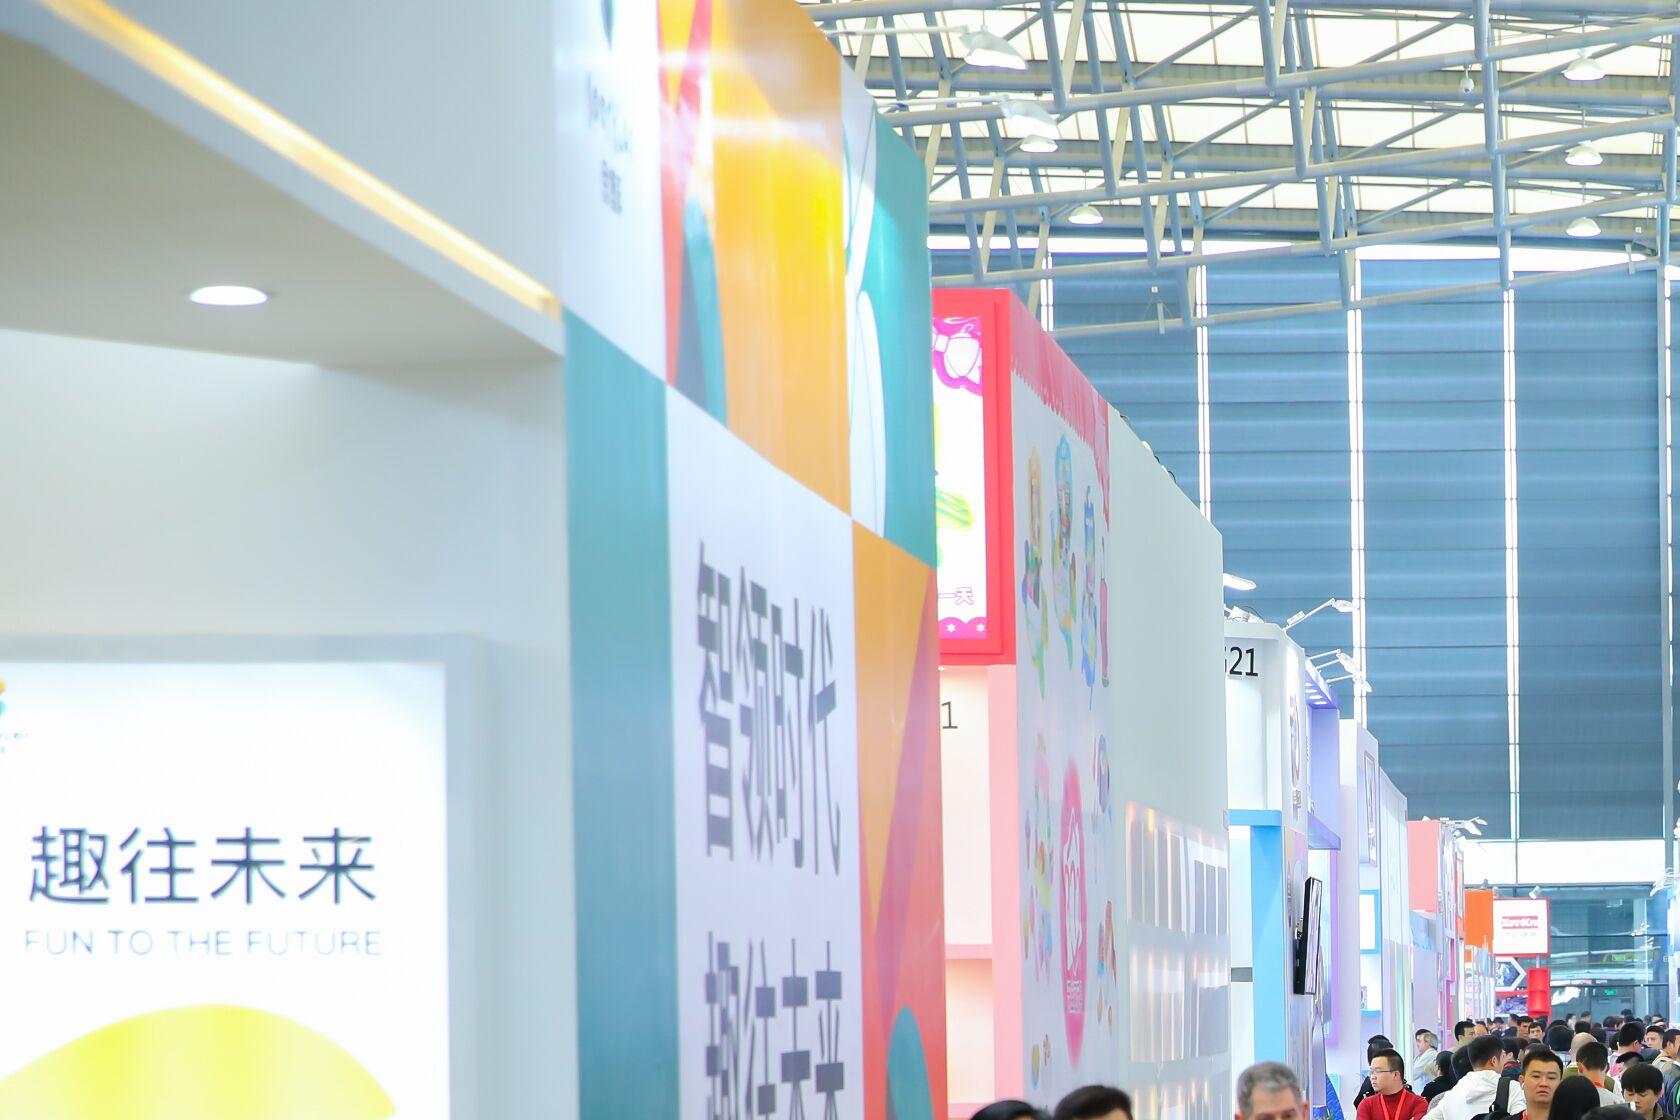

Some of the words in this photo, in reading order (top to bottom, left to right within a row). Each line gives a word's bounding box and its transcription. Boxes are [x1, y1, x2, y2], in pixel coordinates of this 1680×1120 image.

[1225, 646, 1259, 677] 21
[697, 540, 841, 878] 智领时代
[29, 825, 376, 904] 趣往未来
[25, 929, 94, 956] FUN
[107, 929, 153, 956] TO
[166, 929, 232, 956] THE
[247, 929, 382, 956] FUTURE
